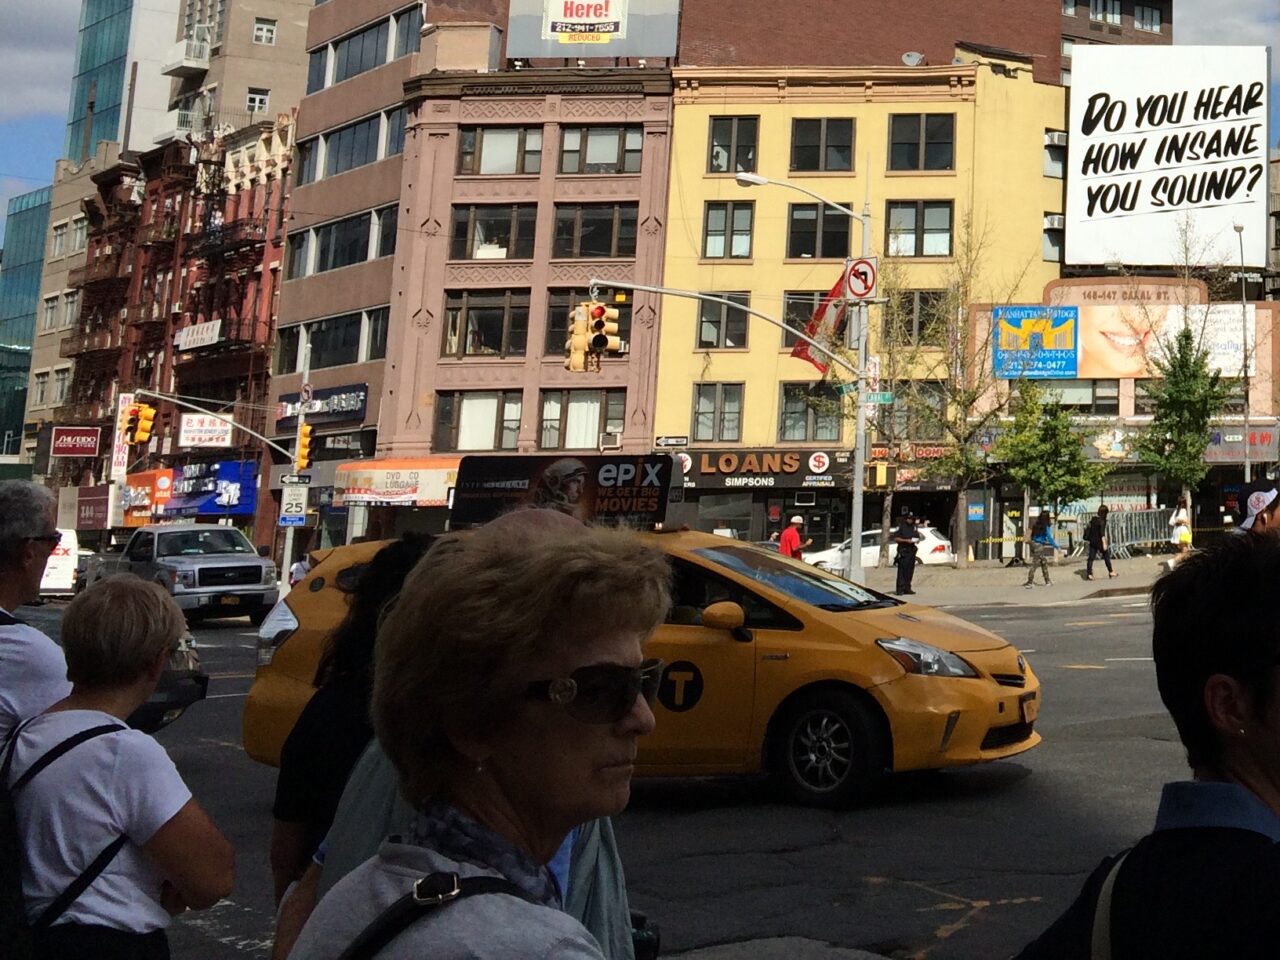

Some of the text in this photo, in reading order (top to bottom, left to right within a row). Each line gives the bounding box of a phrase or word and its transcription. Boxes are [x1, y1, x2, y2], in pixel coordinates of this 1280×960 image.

[563, 0, 610, 18] Here!
[1081, 82, 1264, 136] DO YOU HEAR
[1081, 123, 1263, 176] HOW INSANE
[1086, 163, 1263, 217] YOU SOUND?
[1121, 290, 1152, 300] CANAL
[55, 435, 96, 444] SHISEIDO
[597, 458, 664, 487] epix
[701, 453, 800, 475] LOANS
[725, 477, 775, 487] SIMPSONS
[616, 487, 641, 497] GET
[643, 487, 660, 497] BIG
[284, 502, 303, 513] 25
[595, 497, 659, 512] MOVIES
[668, 671, 694, 705] T
